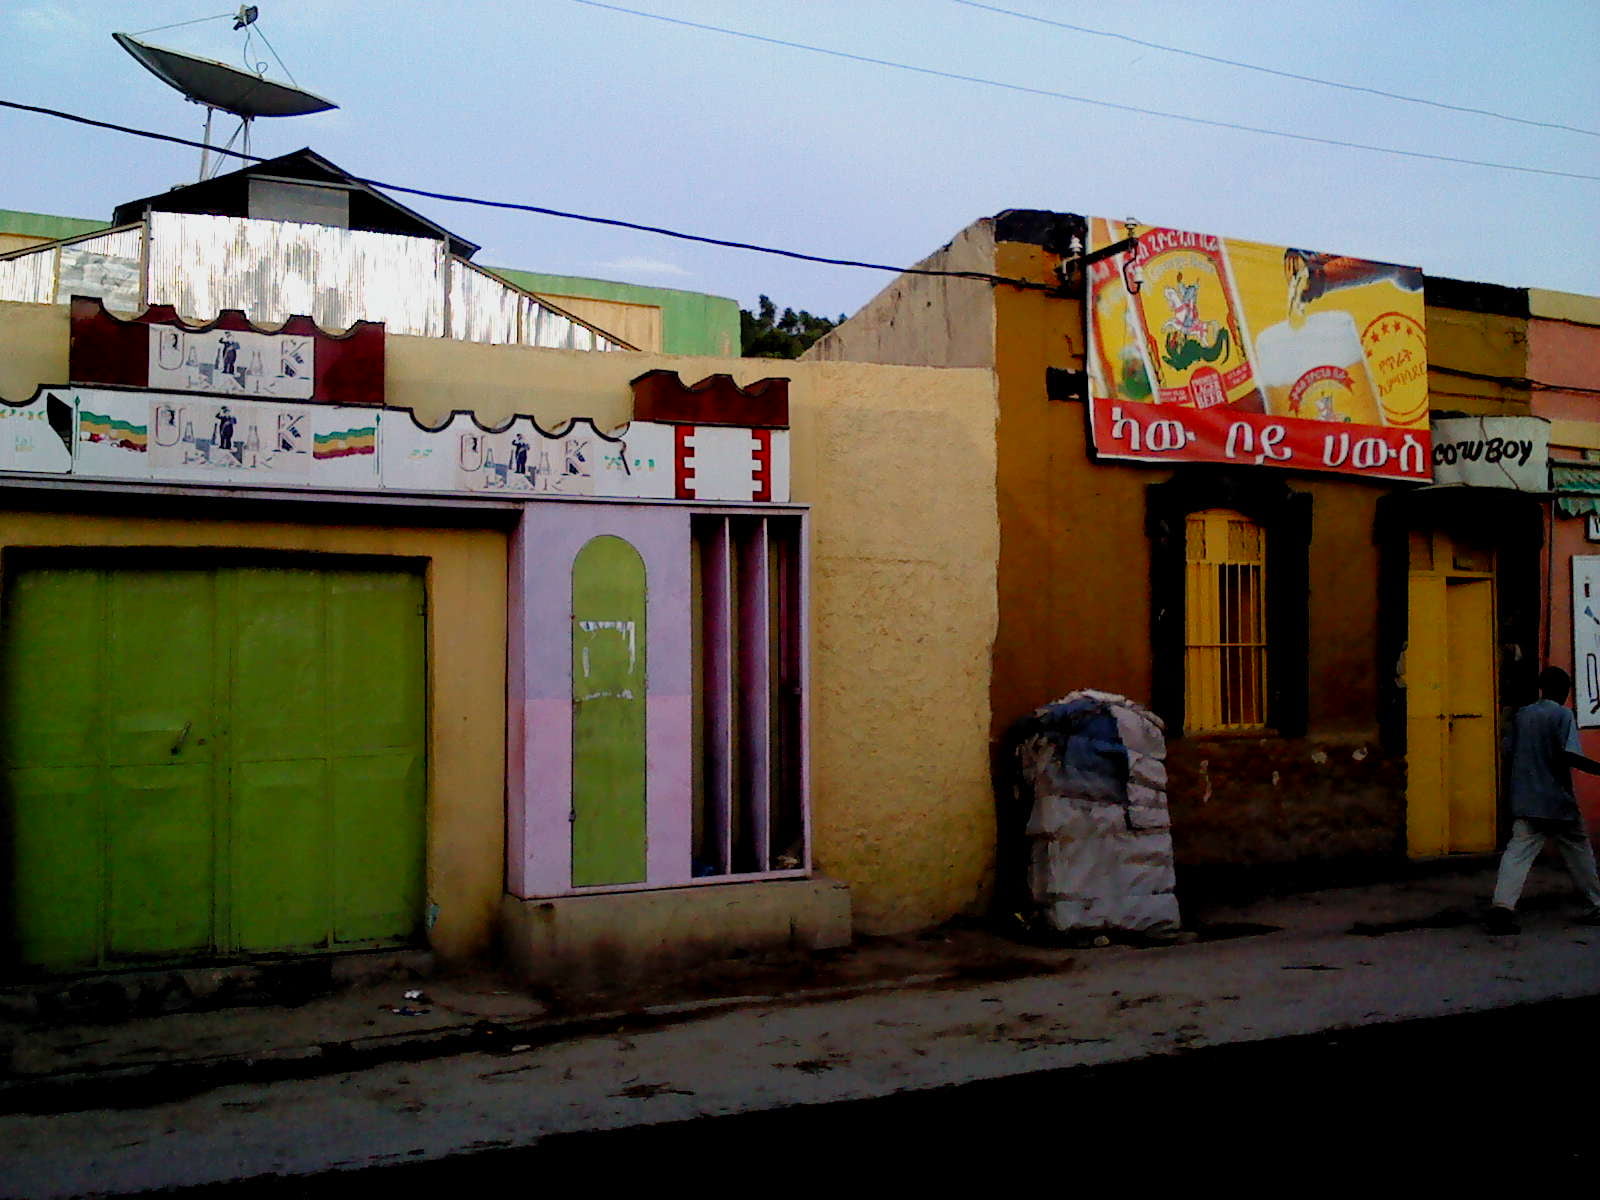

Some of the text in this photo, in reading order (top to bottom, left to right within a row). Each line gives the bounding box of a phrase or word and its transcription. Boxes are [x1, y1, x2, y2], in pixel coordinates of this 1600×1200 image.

[1112, 407, 1425, 473] ካው ቦይ ሀውስ
